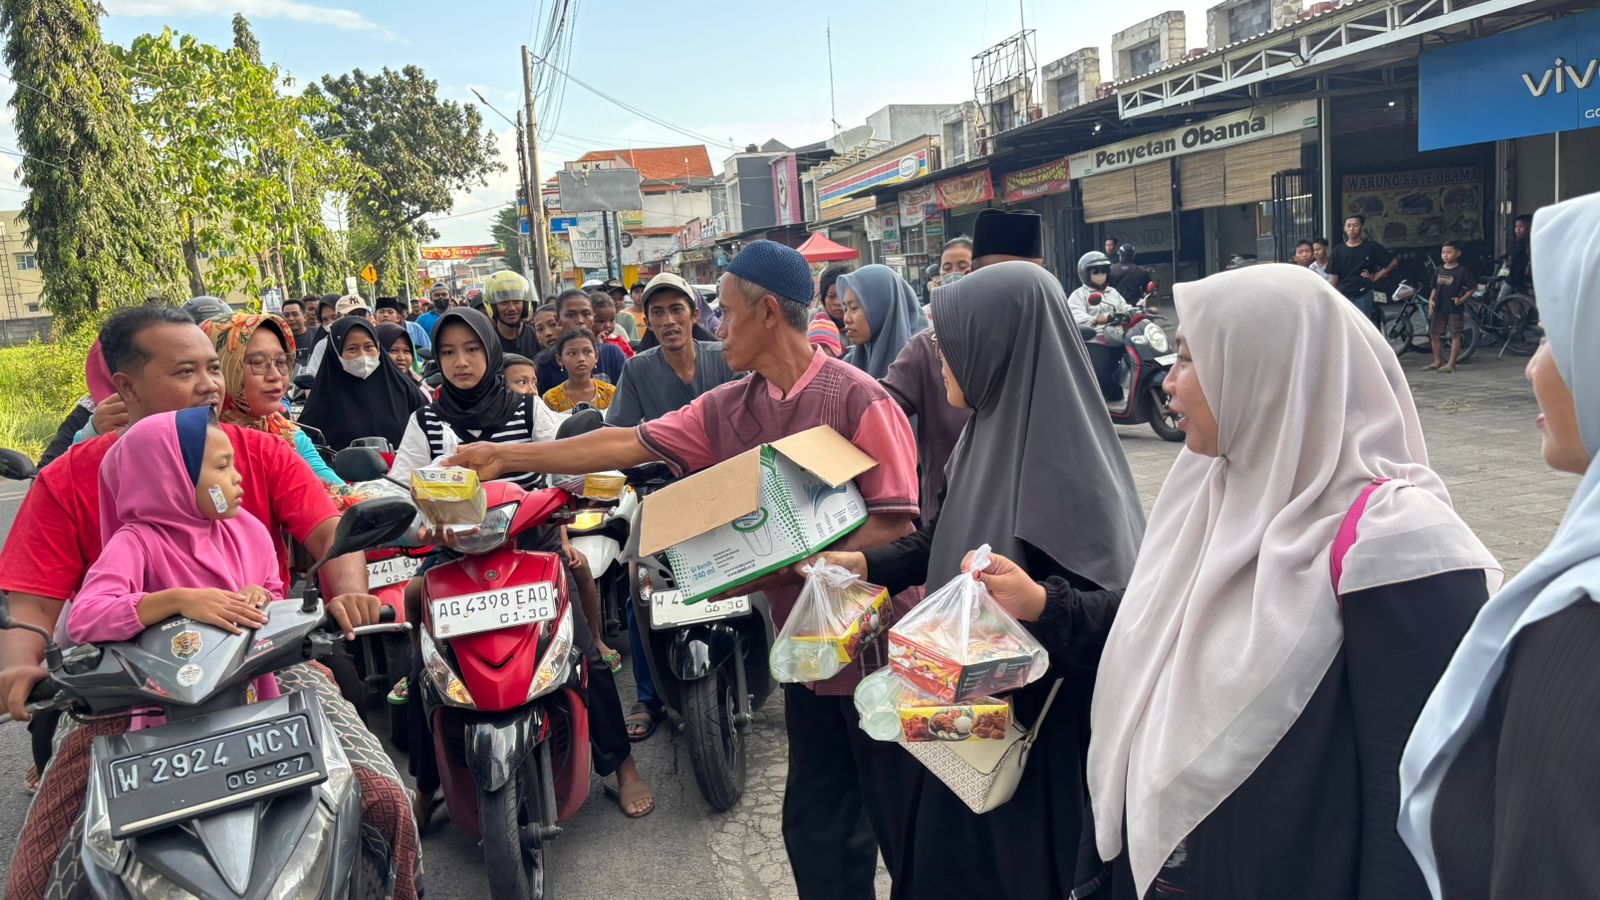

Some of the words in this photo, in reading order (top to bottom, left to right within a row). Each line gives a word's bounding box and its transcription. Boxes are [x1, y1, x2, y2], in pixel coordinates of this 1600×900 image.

[1521, 57, 1600, 97] viv
[1096, 137, 1177, 168] Penyetan
[1181, 115, 1267, 149] Obama
[1347, 174, 1400, 190] WARUNG
[1403, 171, 1434, 187] SATE
[1436, 168, 1478, 185] OBAMA
[693, 571, 706, 580] 240
[707, 566, 716, 576] ml
[439, 601, 461, 618] AG
[465, 592, 510, 614] 4398
[655, 595, 664, 606] W
[117, 764, 139, 793] W
[151, 742, 231, 784] 2924
[246, 723, 300, 758] NCY
